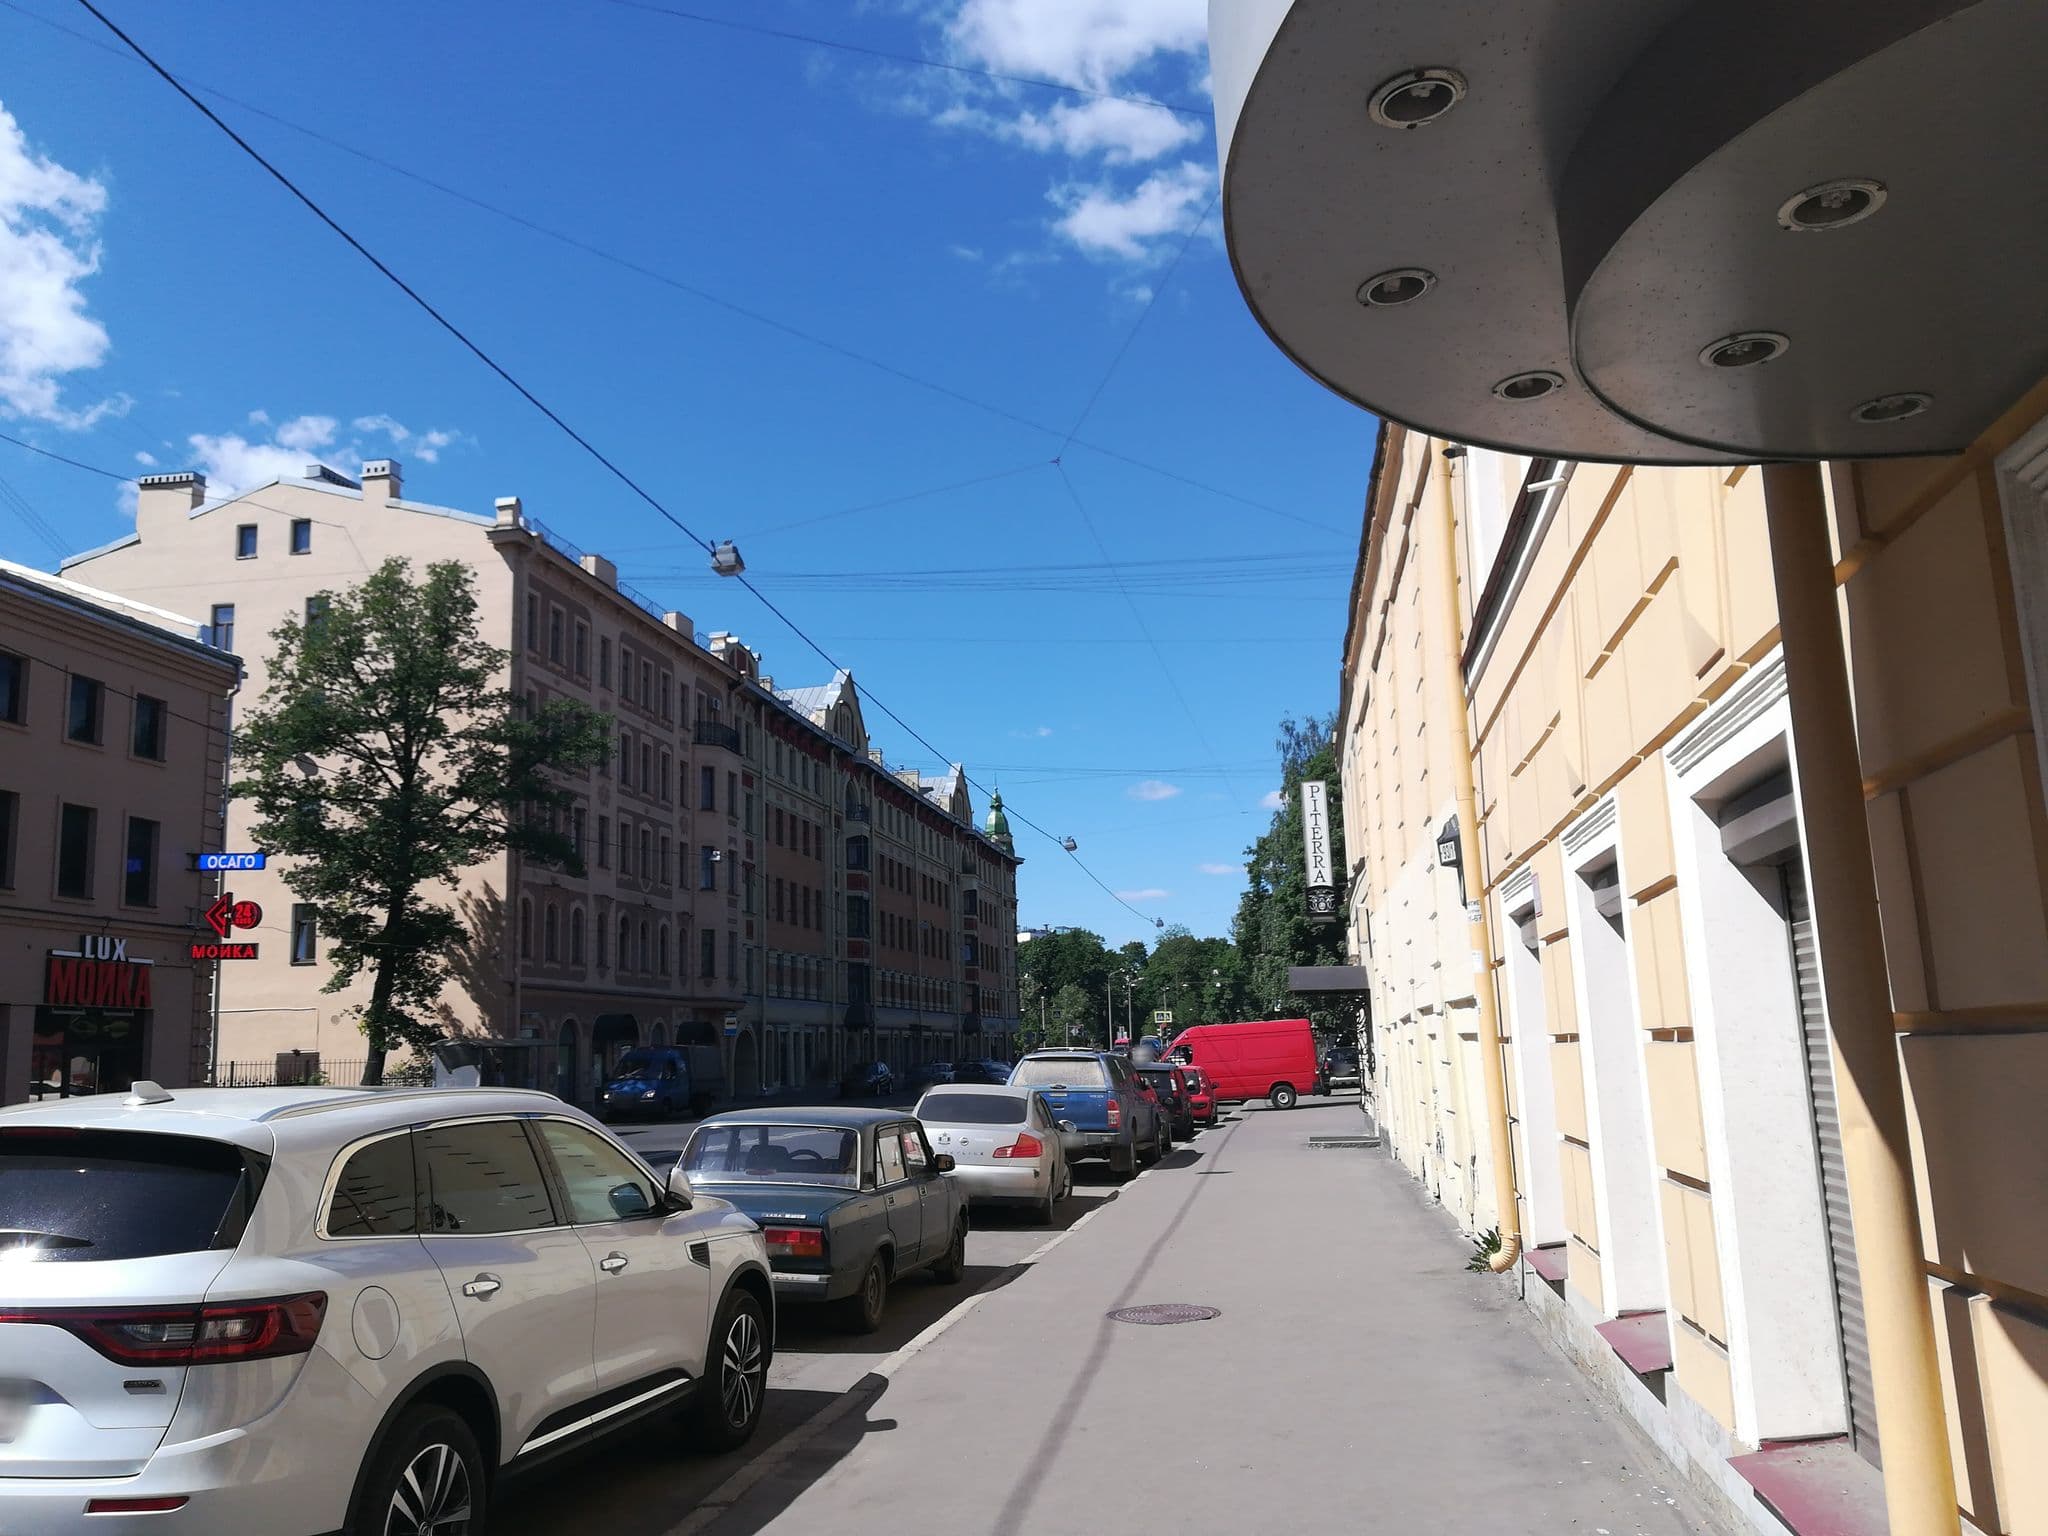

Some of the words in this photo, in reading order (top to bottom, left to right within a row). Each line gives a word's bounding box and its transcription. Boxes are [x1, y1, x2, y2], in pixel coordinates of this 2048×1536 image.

[1308, 784, 1326, 883] PITERRA
[207, 855, 256, 869] ОСАГО
[84, 935, 127, 962] LUX
